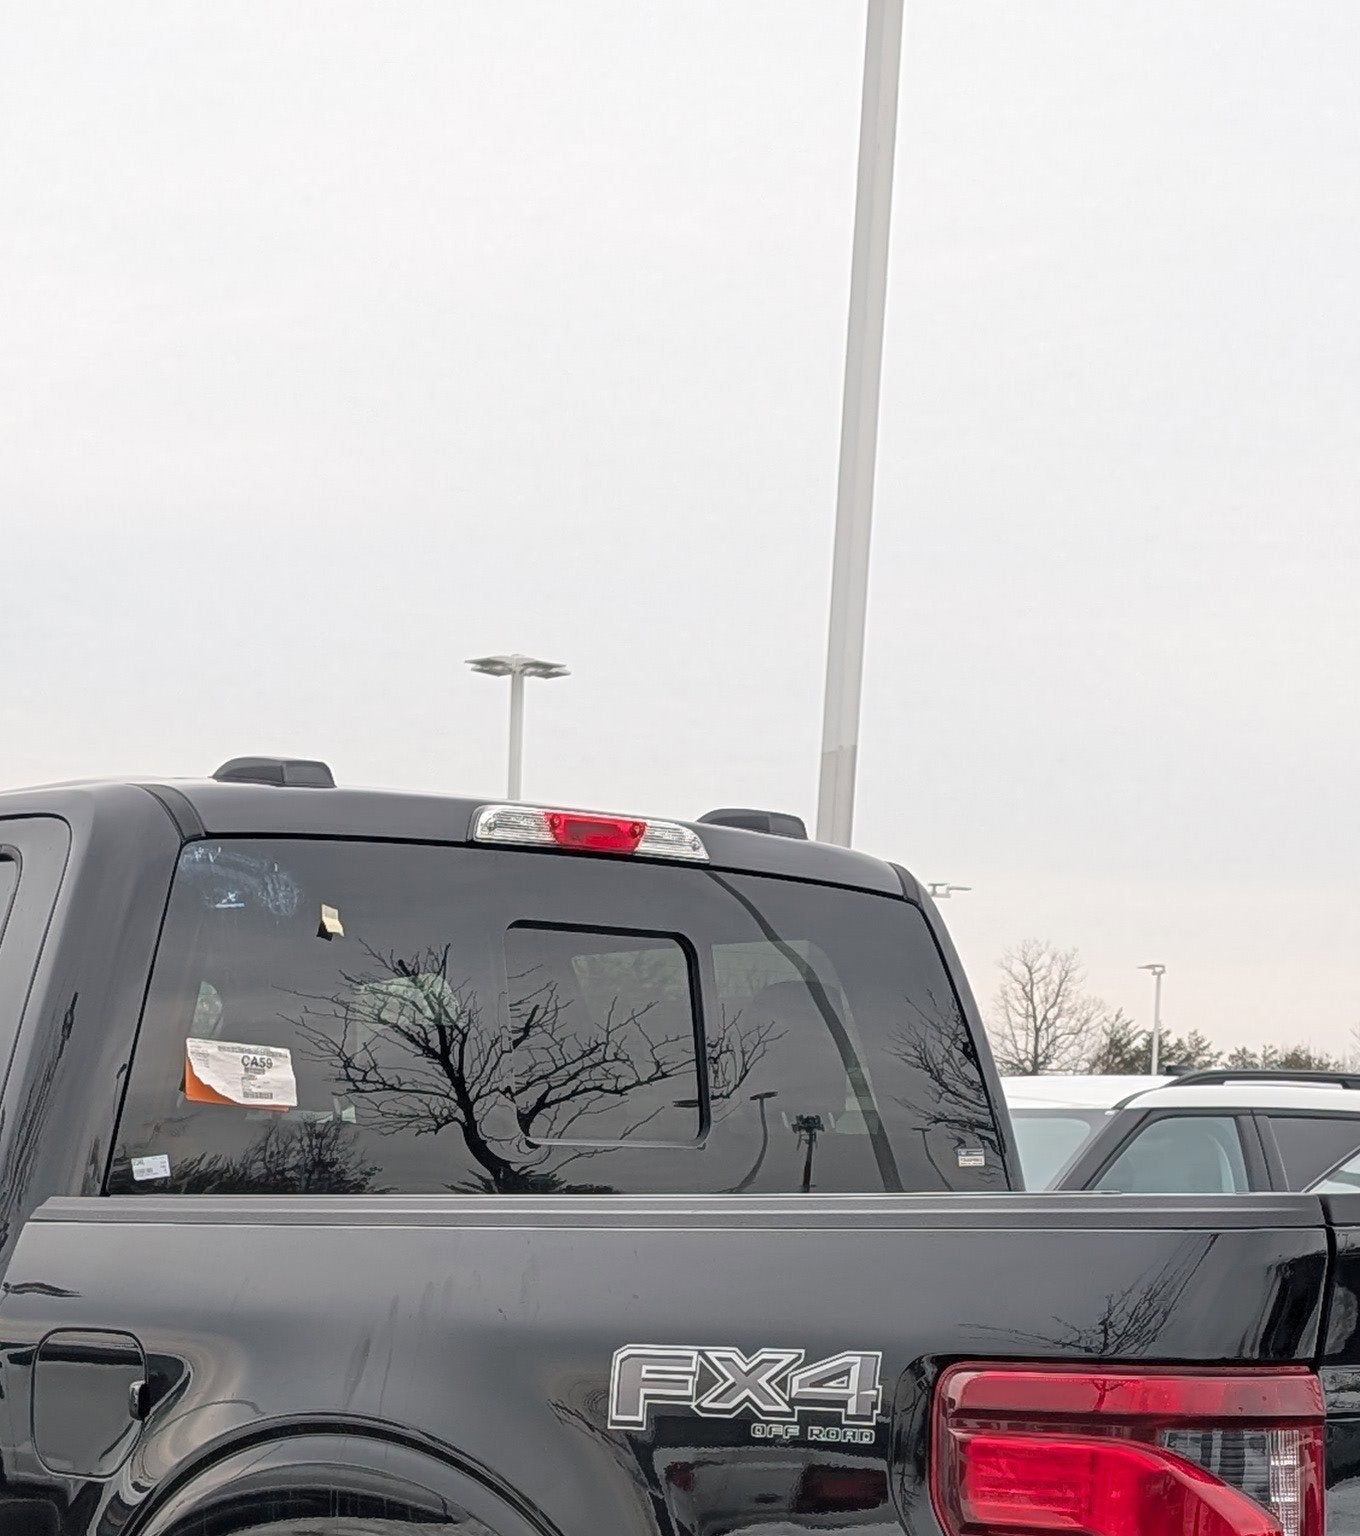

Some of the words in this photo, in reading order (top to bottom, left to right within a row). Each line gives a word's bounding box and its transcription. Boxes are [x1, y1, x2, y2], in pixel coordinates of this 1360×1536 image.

[241, 1055, 274, 1070] CA59
[607, 1344, 883, 1431] FX4
[751, 1423, 800, 1439] OFF
[808, 1426, 876, 1445] ROAD
